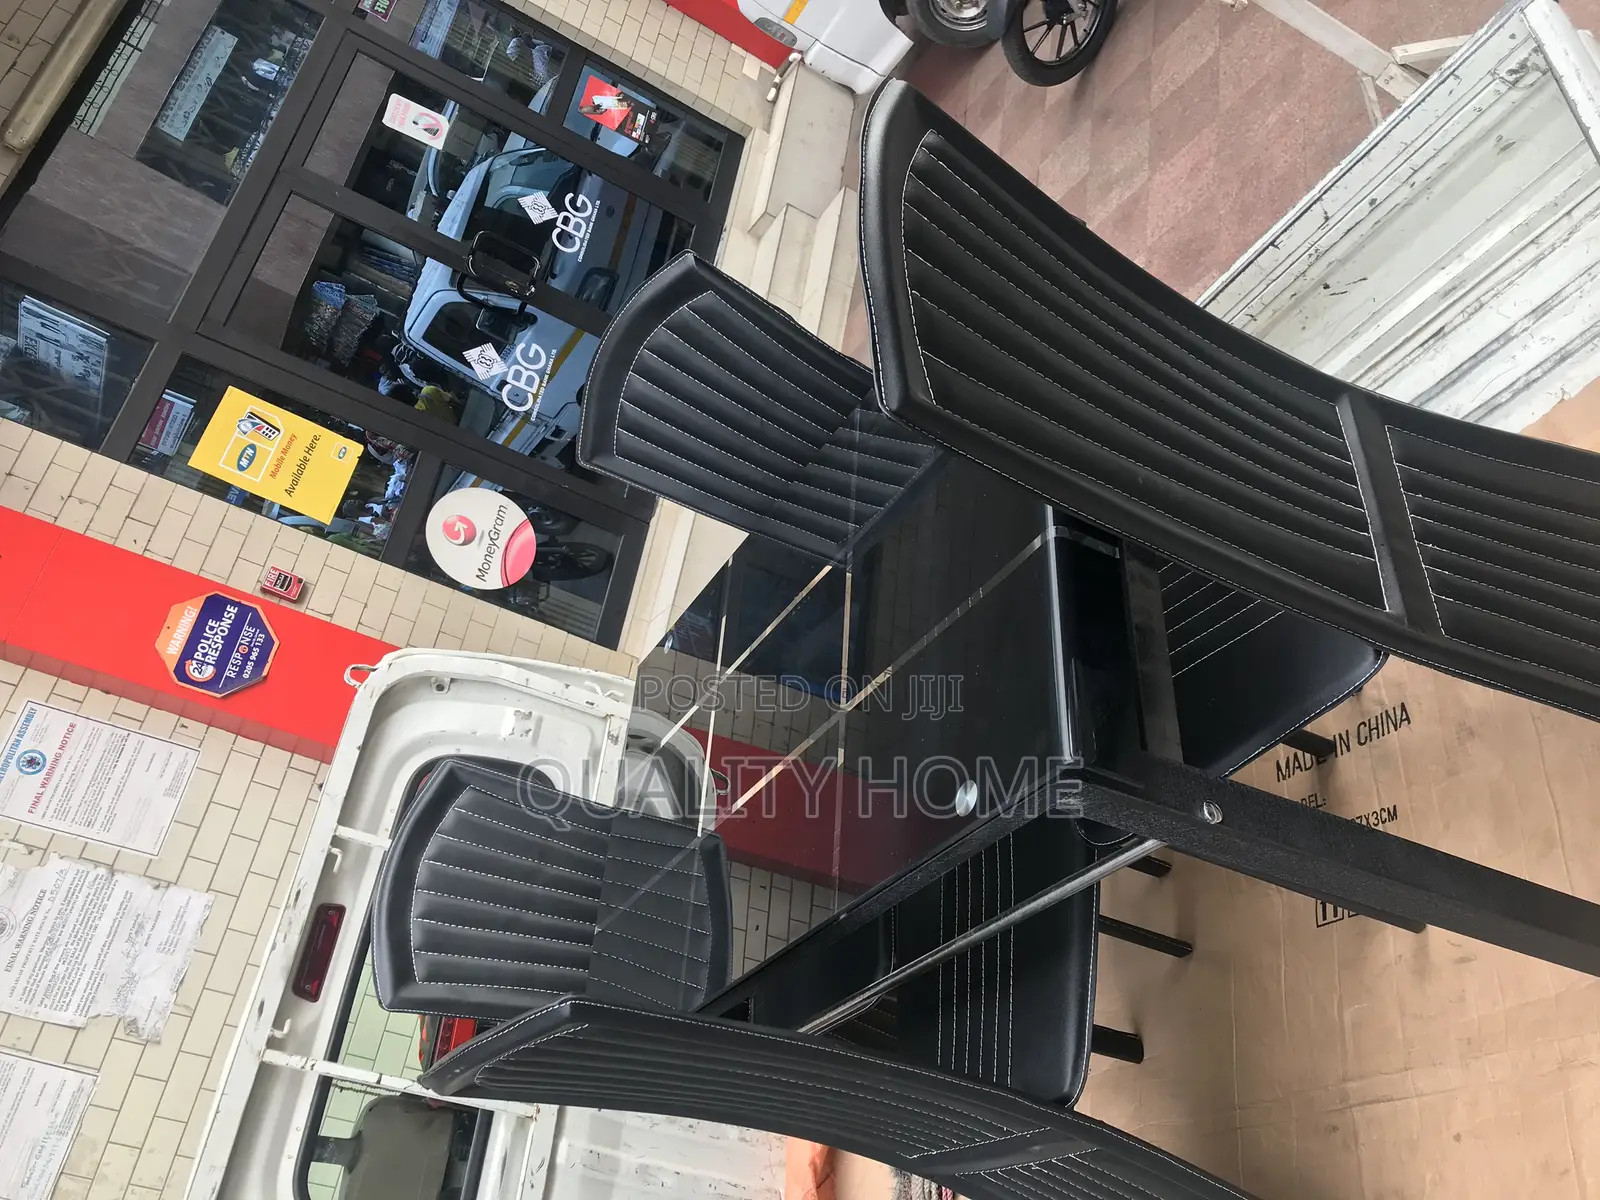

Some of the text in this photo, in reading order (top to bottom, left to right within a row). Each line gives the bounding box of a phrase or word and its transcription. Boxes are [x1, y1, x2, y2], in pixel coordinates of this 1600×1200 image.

[551, 192, 591, 252] CBG
[577, 232, 590, 262] CONSOLIDATED
[590, 207, 598, 222] GHANA
[502, 342, 545, 410] CBG
[530, 386, 545, 421] CONSOLIDATED
[541, 373, 549, 387] BANK
[545, 357, 554, 374] GHANA
[238, 446, 255, 468] MTN
[268, 431, 297, 479] Mobile Money
[284, 430, 321, 497] Available Here.
[337, 446, 346, 458] MTN
[475, 503, 507, 582] MoneyGram
[264, 568, 278, 587] FIRE
[167, 606, 198, 655] WARNING!
[194, 618, 221, 661] POLICE
[206, 604, 239, 664] RESPONSE
[249, 646, 260, 661] 965
[254, 632, 265, 646] 133
[192, 661, 204, 675] 24
[242, 660, 255, 680] 0205
[0, 738, 22, 780] ETROPOLITAN
[16, 706, 38, 739] ASSEMBLY
[1333, 729, 1351, 758] IN
[1357, 702, 1412, 747] CHINA
[28, 790, 44, 814] FINAL
[41, 751, 61, 788] WARNING
[59, 722, 77, 751] NOTICE
[1351, 805, 1398, 828] 7X3CM
[3, 887, 46, 973] FINAL WARNING NOTICE
[20, 943, 35, 969] PROPERTY
